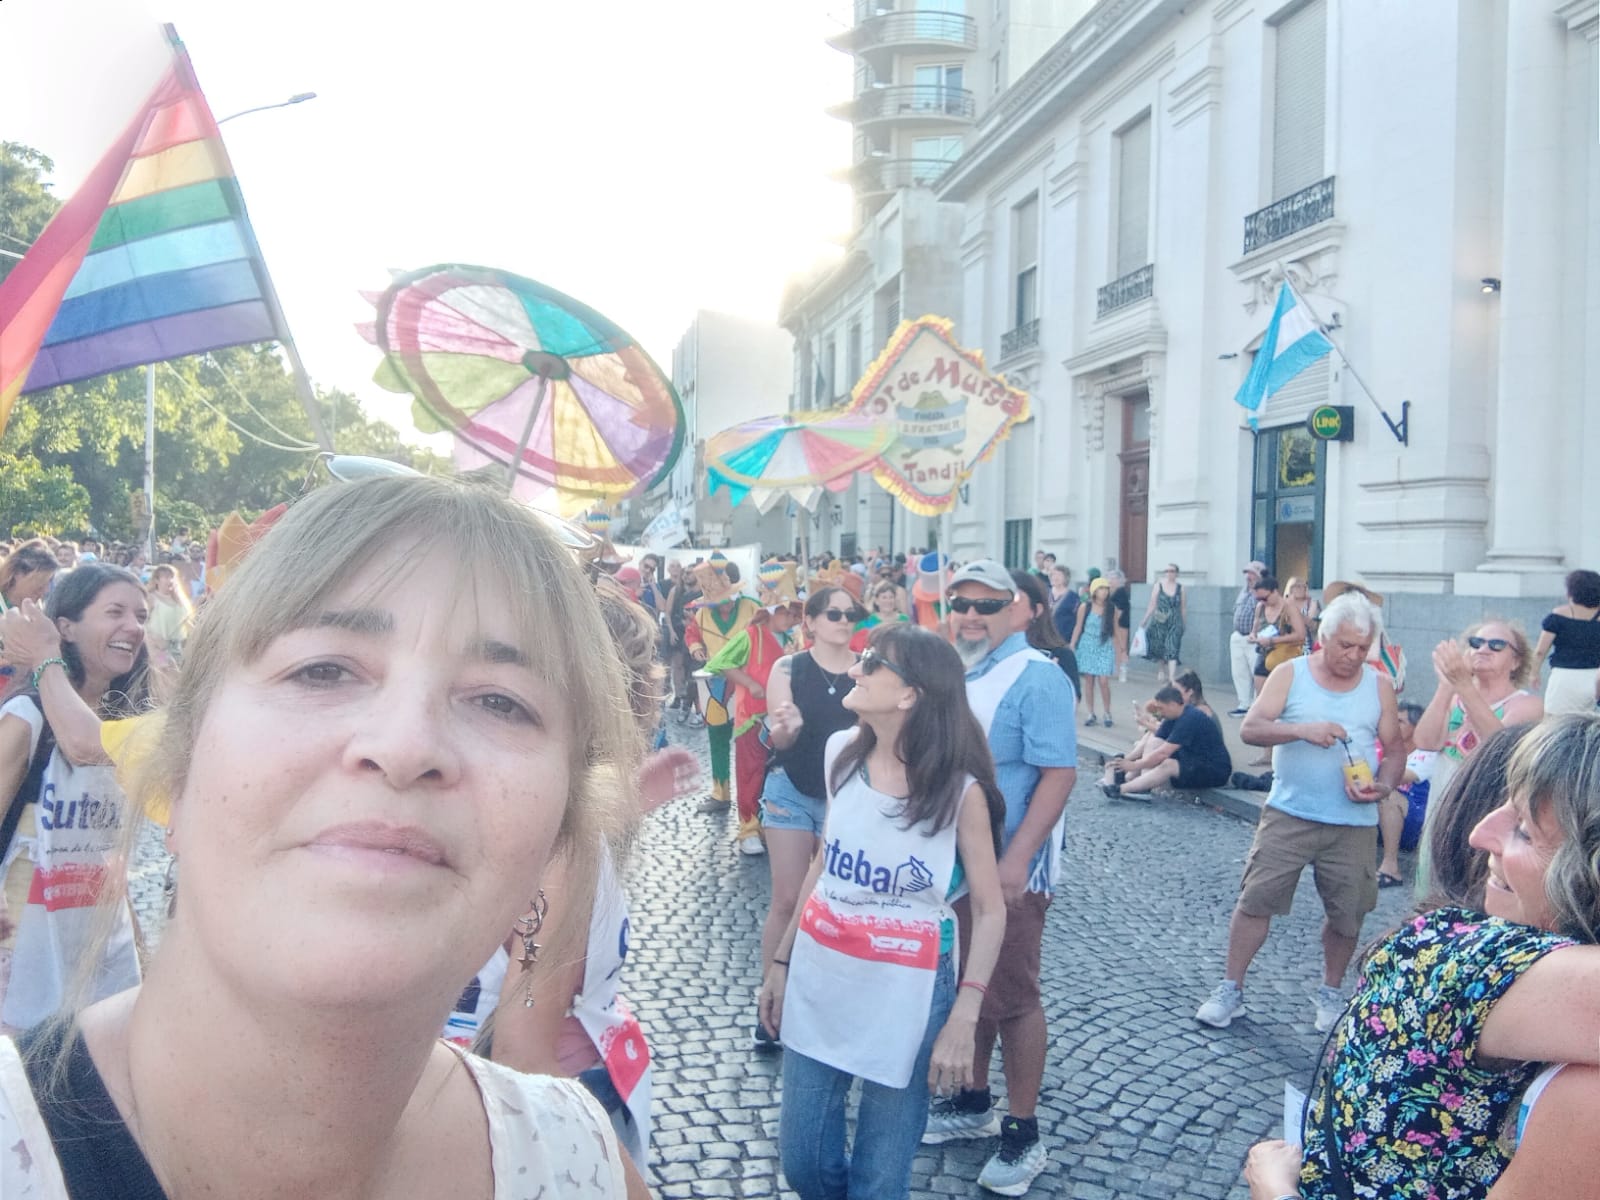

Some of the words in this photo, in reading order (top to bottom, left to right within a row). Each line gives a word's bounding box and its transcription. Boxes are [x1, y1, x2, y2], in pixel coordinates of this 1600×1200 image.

[898, 371, 920, 392] de
[924, 357, 1022, 416] Murga
[1316, 415, 1339, 428] LINK
[903, 459, 965, 483] Tandil
